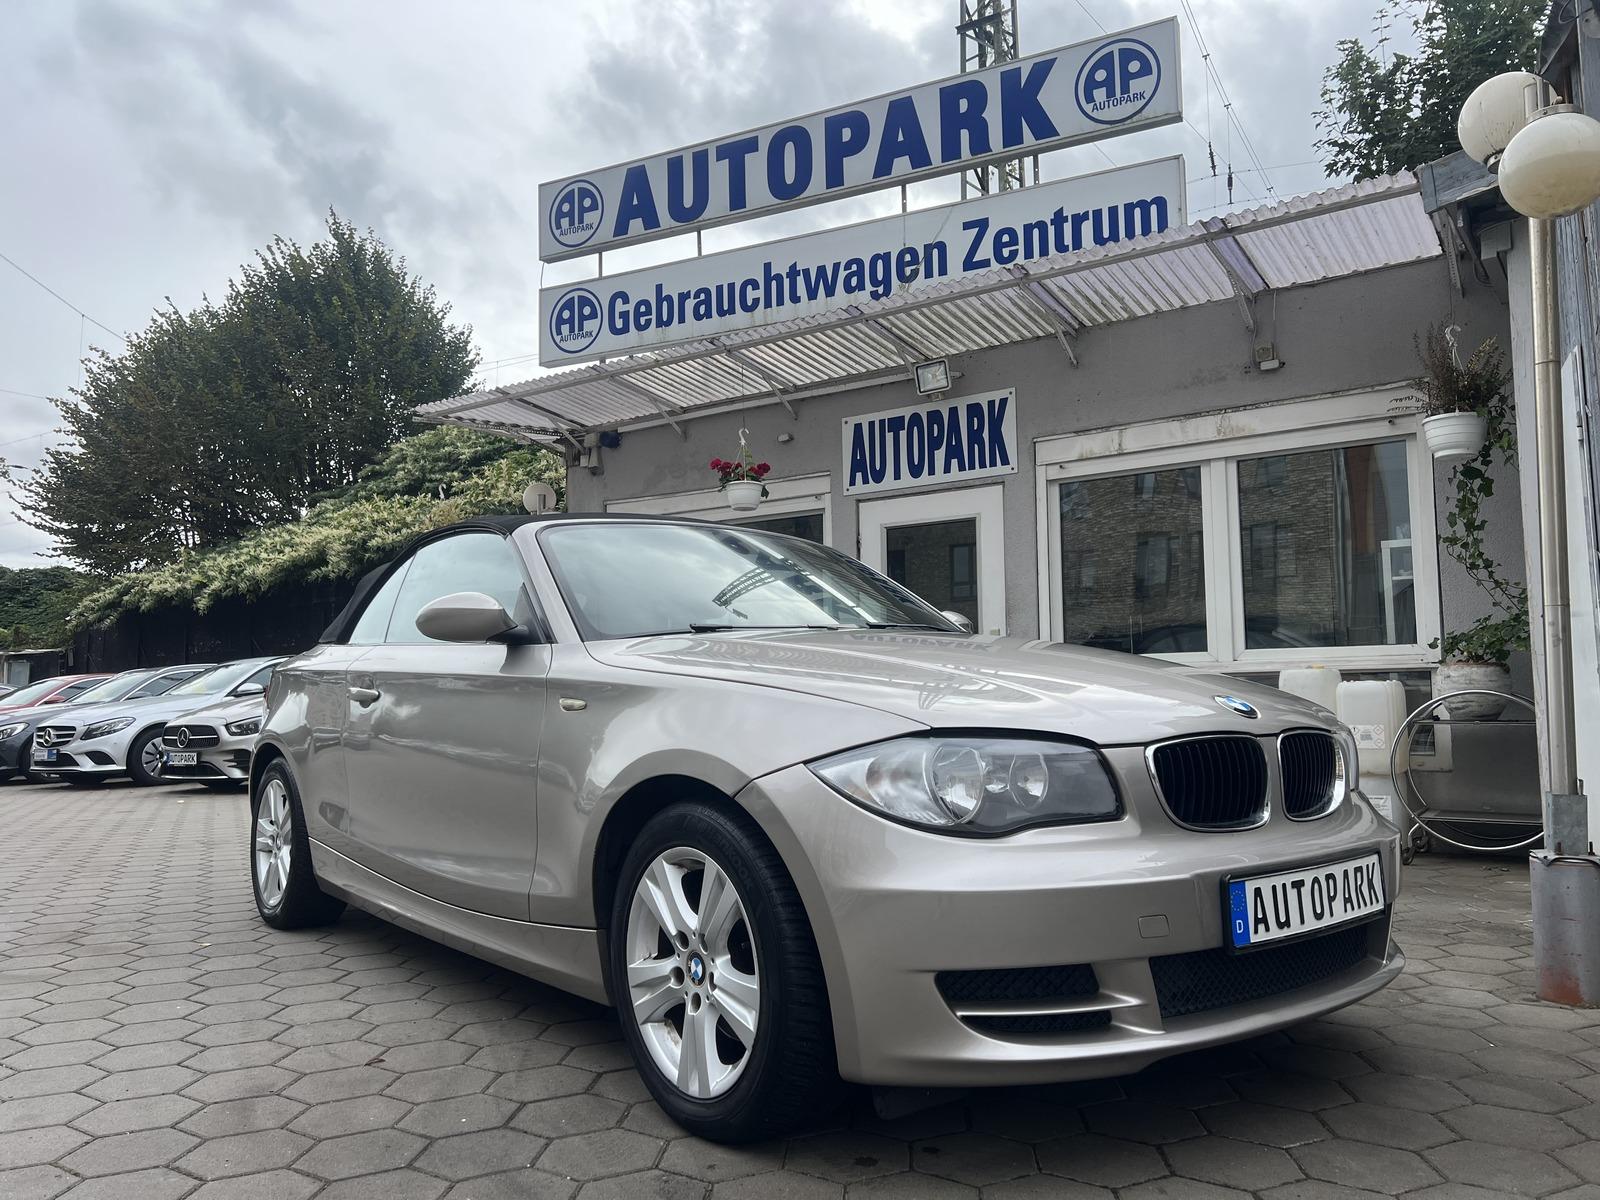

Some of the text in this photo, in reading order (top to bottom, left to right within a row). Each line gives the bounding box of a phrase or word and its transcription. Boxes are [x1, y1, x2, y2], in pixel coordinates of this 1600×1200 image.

[1084, 47, 1153, 104] AP
[1091, 90, 1147, 112] AUTOPARK
[612, 56, 1060, 238] AUTOPARK
[554, 186, 599, 230] AP
[560, 222, 595, 236] AUTOPARK
[608, 195, 1169, 337] Gebrauchtwagen Zentrum
[555, 295, 598, 336] AP
[560, 330, 594, 343] AUTOPARK
[849, 397, 1010, 487] AUTOPARK
[1253, 862, 1379, 934] AUTOPARK
[1236, 920, 1244, 934] D
